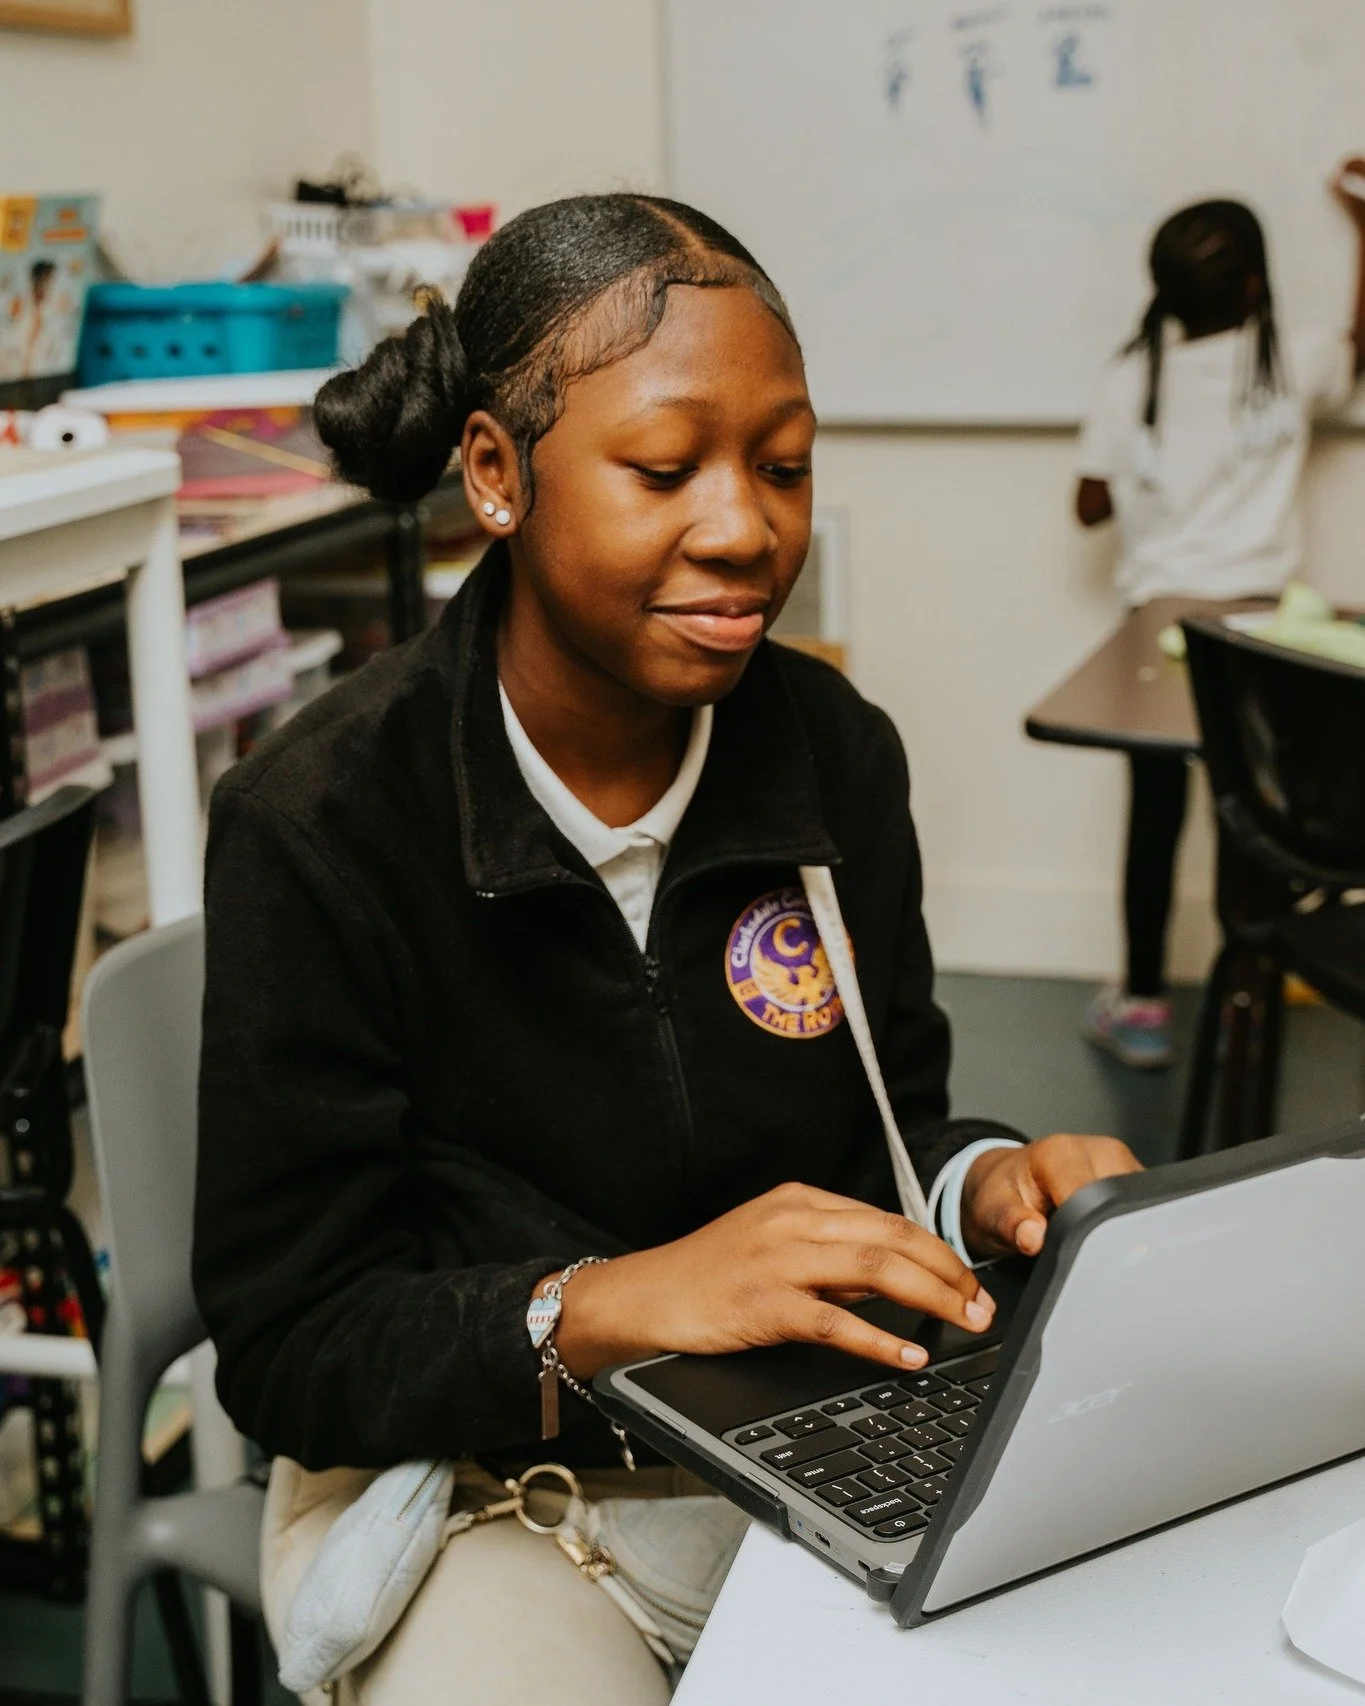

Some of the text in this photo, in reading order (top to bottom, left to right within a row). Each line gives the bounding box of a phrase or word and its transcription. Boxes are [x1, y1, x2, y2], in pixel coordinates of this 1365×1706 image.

[772, 915, 810, 958] C
[1047, 1381, 1134, 1424] acer
[774, 1450, 794, 1460] shift
[803, 1467, 825, 1478] enter
[859, 1497, 903, 1515] backspace
